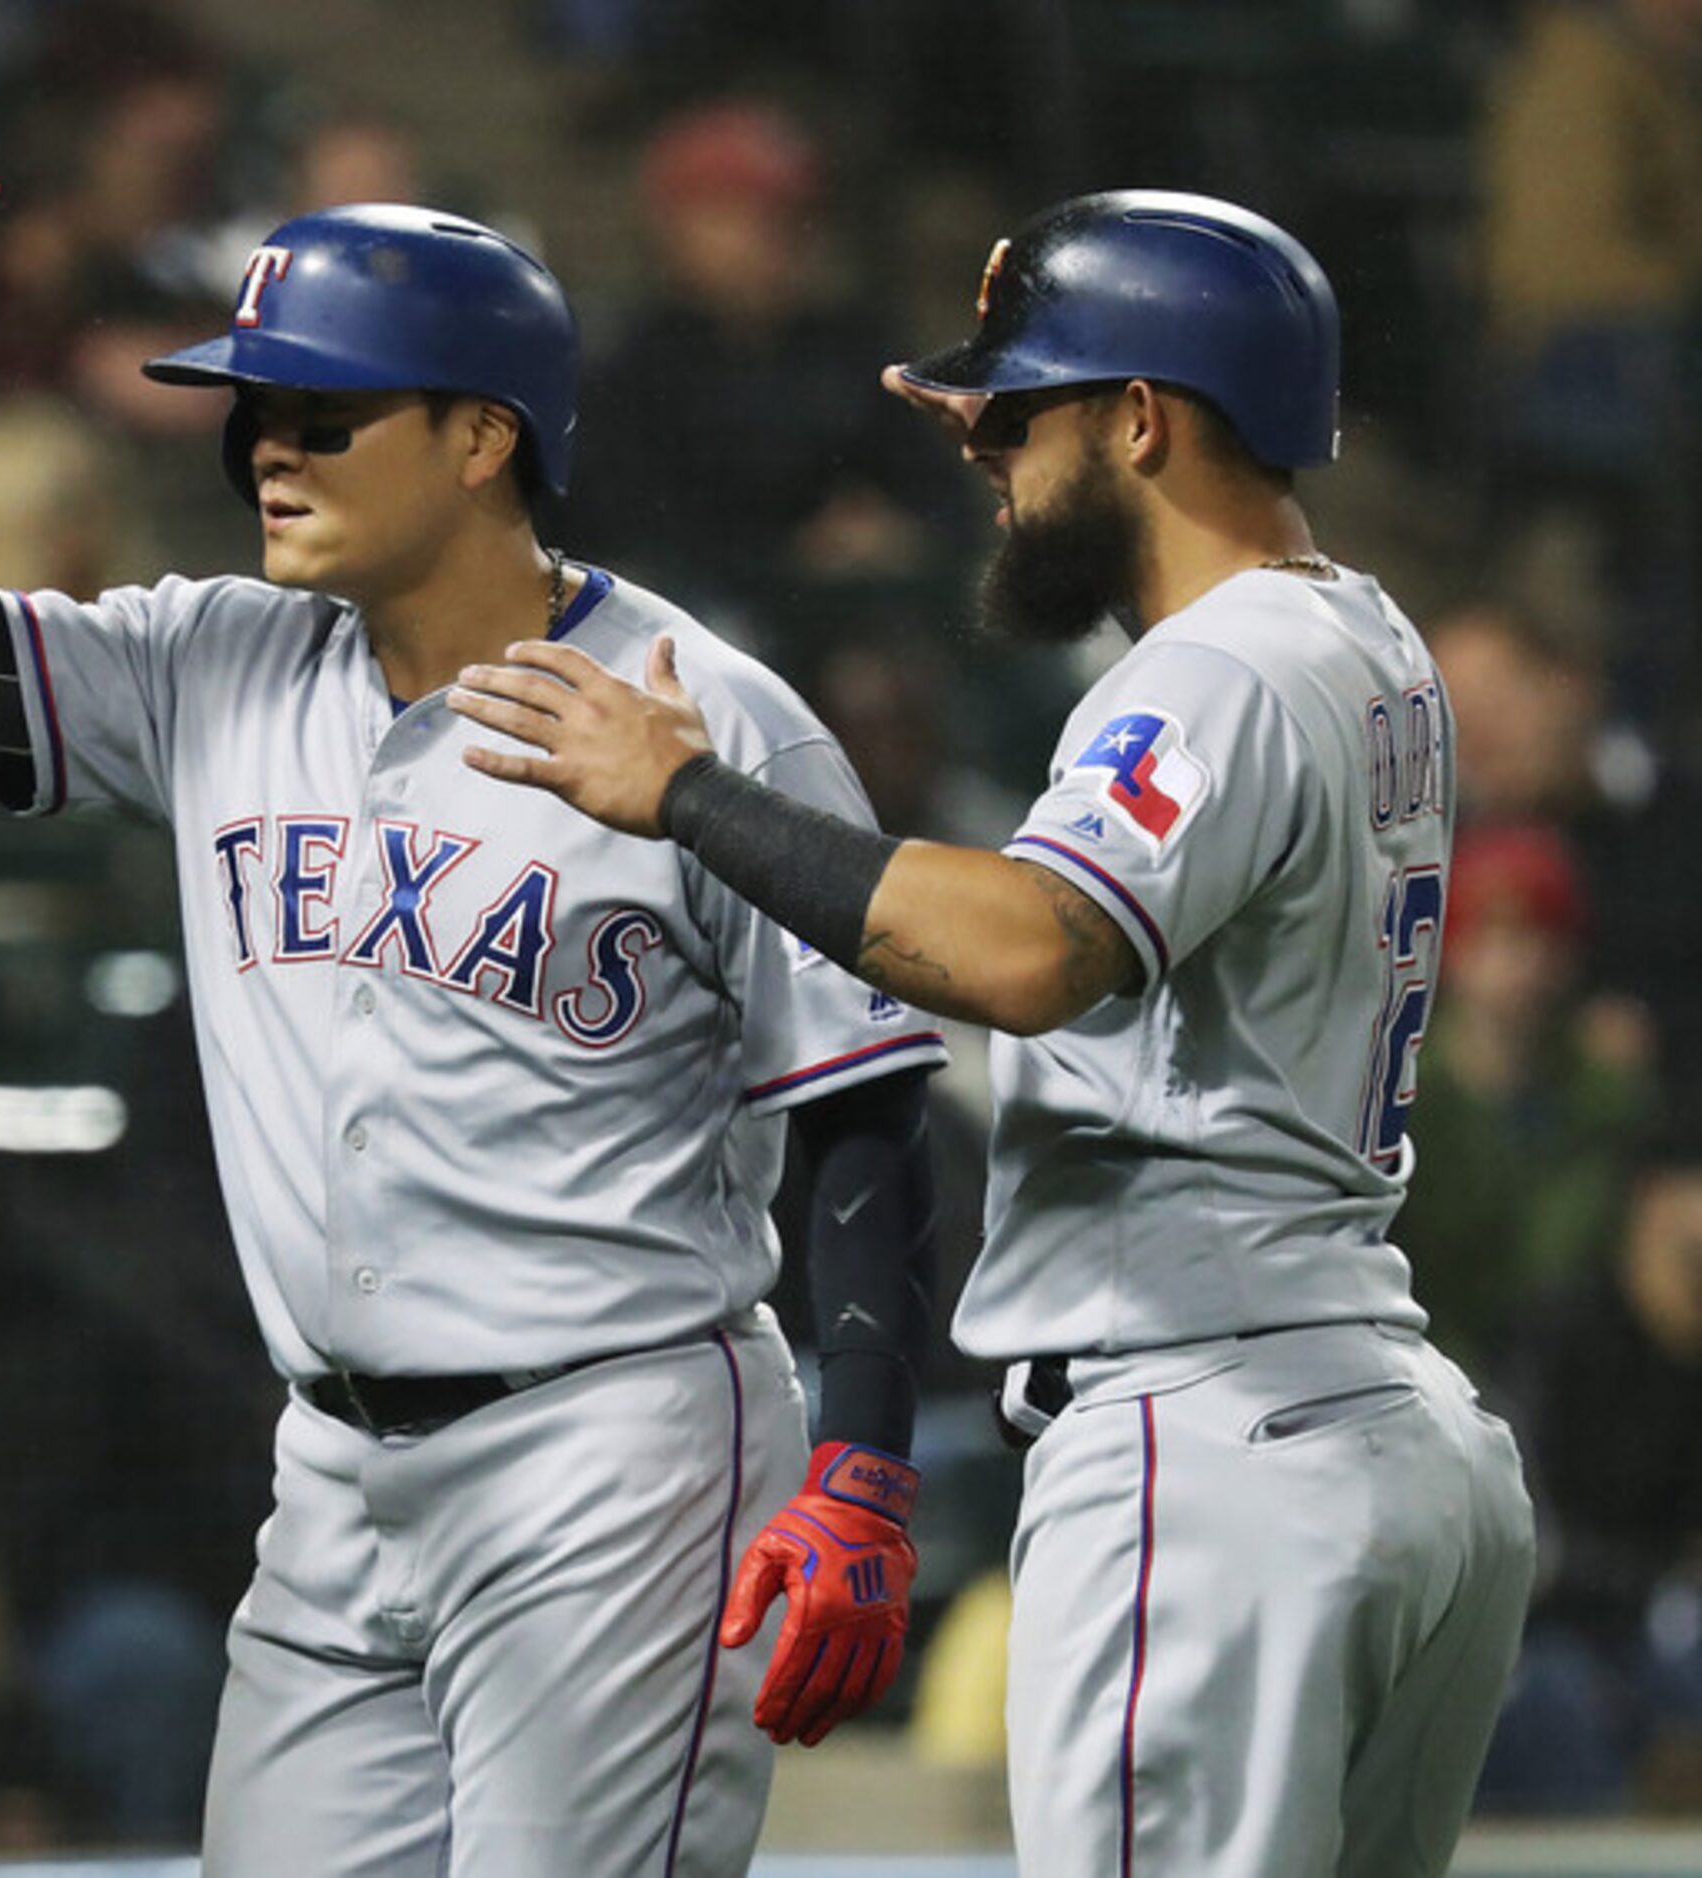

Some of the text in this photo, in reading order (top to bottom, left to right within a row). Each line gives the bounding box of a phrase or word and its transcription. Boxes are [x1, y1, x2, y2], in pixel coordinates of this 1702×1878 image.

[236, 246, 293, 329] T
[214, 816, 662, 1049] TEXAS
[1356, 864, 1442, 1162] 12
